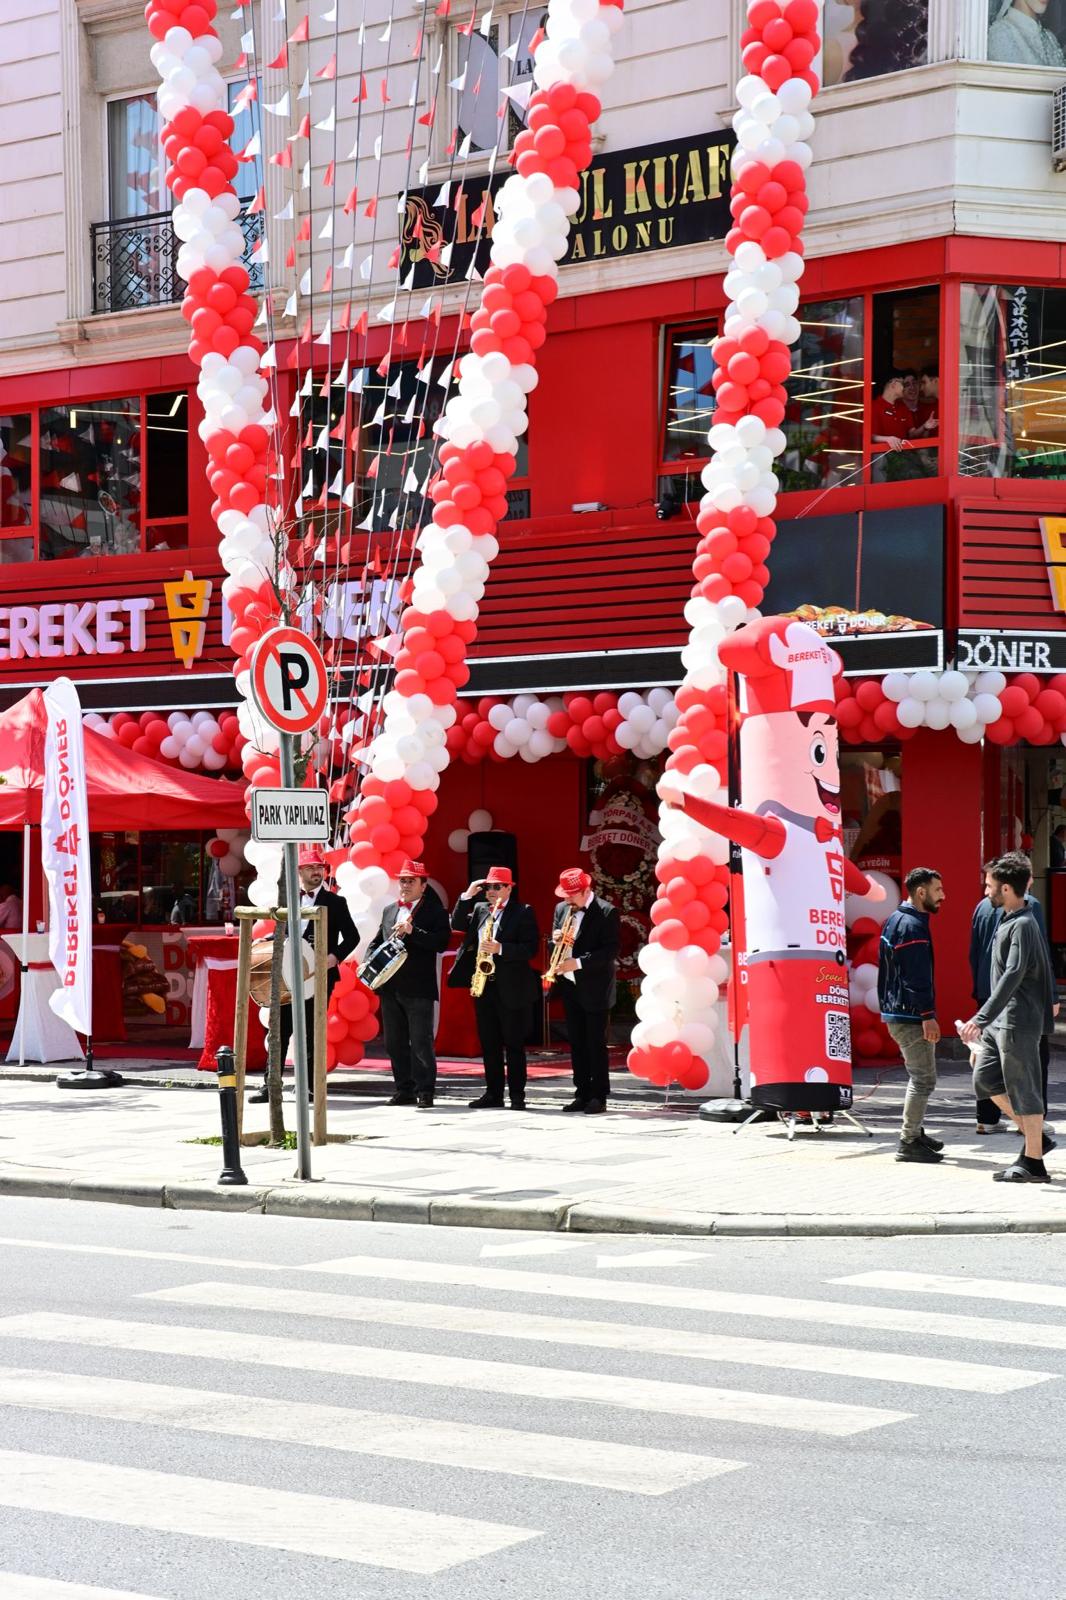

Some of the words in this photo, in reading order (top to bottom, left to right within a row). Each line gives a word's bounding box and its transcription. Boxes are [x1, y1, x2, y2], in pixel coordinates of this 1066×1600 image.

[624, 144, 730, 215] KUAF
[571, 217, 674, 259] ALONU
[788, 650, 821, 663] BEREKET
[957, 635, 1053, 668] DÖNER
[259, 805, 282, 825] PARK
[284, 805, 325, 826] YAPILMAZ
[620, 832, 650, 850] DÖNER
